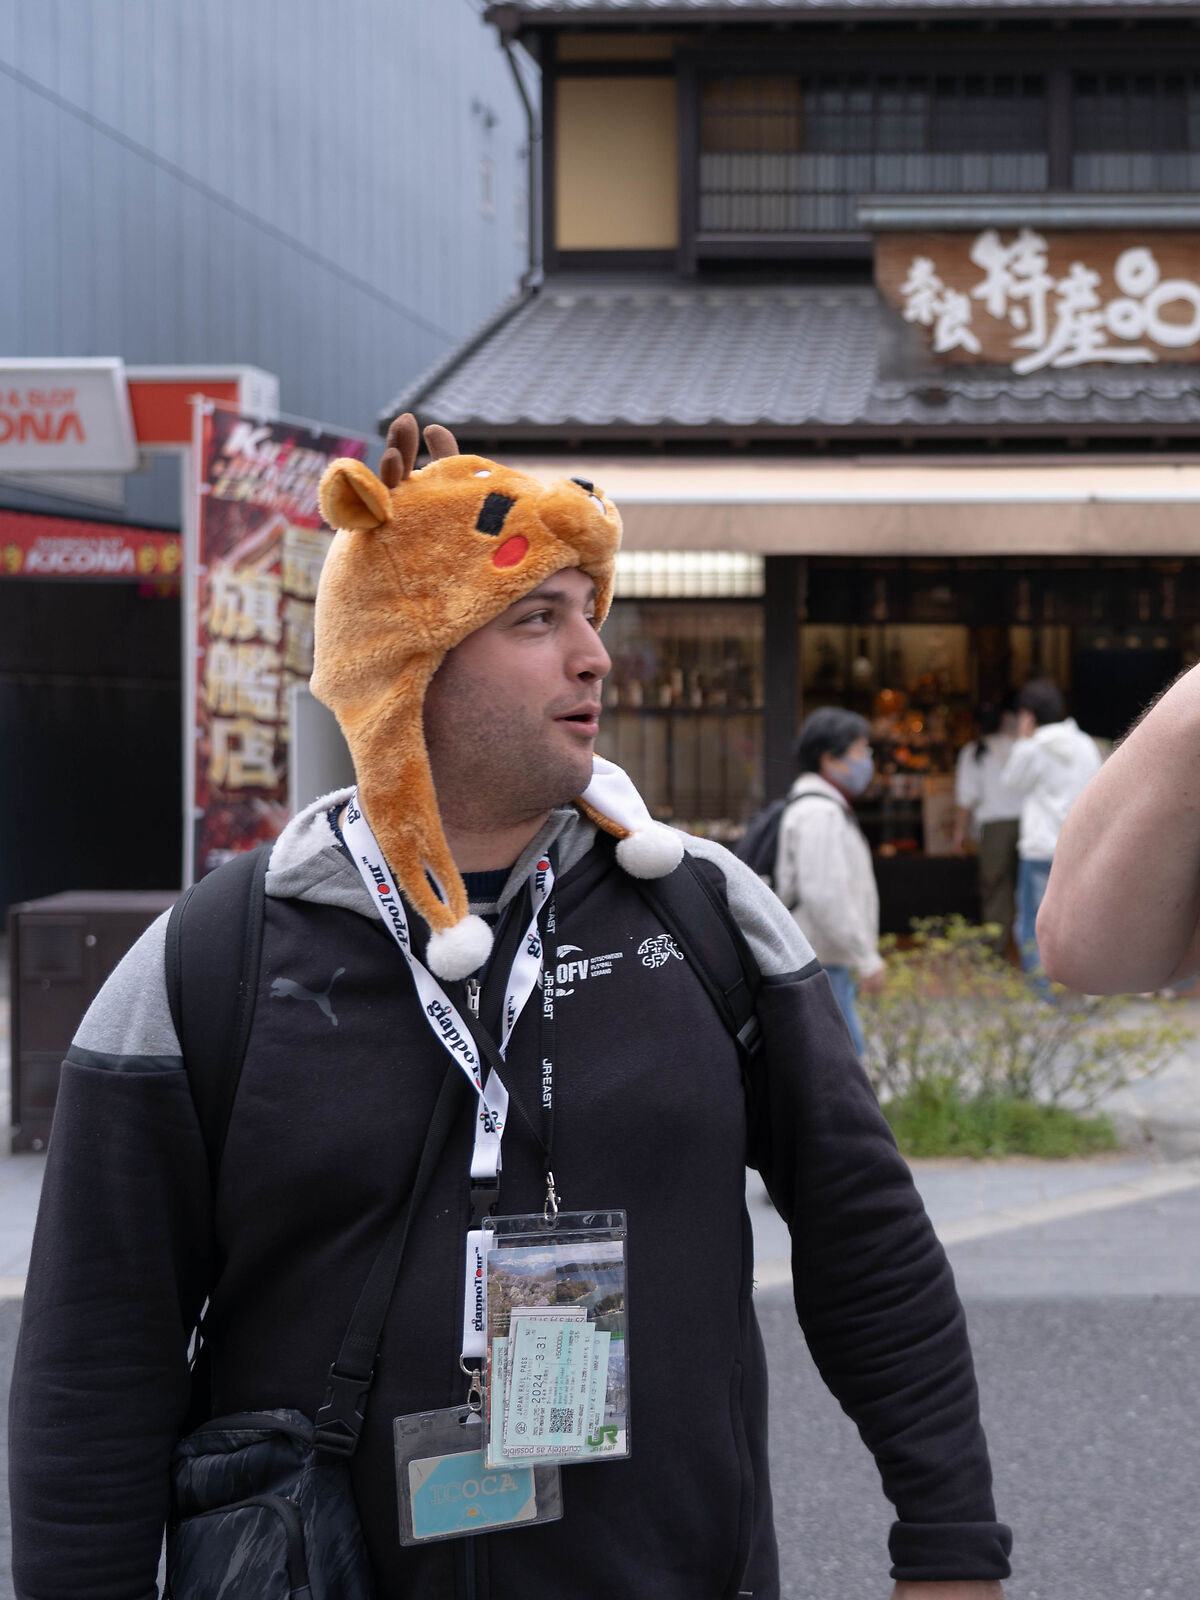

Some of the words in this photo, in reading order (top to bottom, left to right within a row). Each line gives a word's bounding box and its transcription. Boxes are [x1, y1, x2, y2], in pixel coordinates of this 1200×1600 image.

[556, 959, 589, 984] OFV
[532, 1374, 543, 1404] 2024
[429, 1473, 518, 1505] ICOCA
